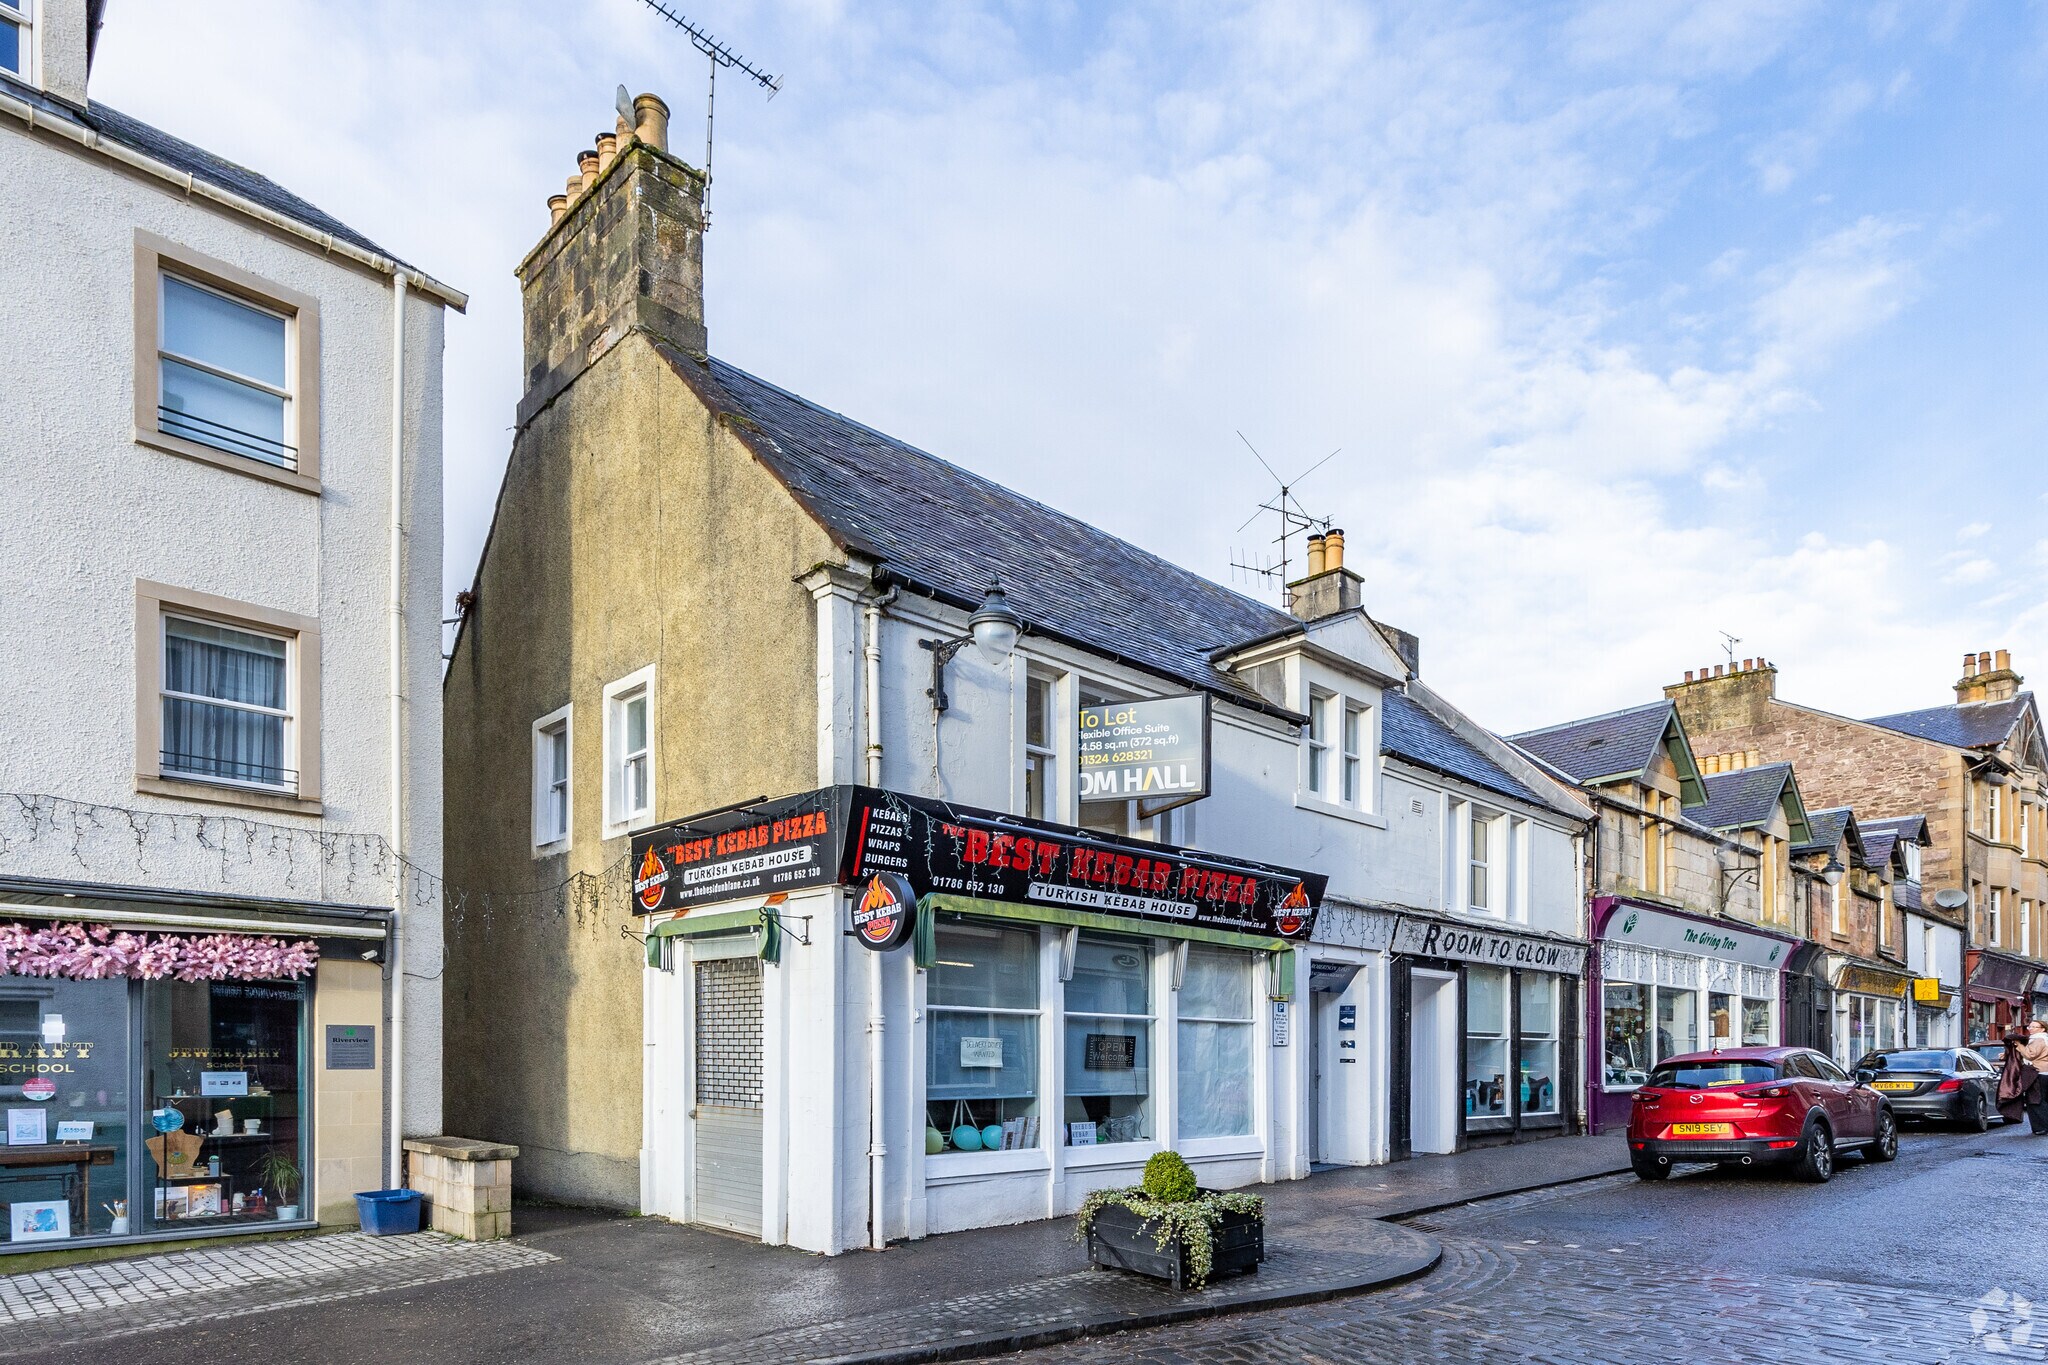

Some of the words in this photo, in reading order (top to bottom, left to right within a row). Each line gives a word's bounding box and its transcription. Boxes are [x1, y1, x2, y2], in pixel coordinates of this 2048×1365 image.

[1079, 711, 1099, 729] To
[1104, 707, 1136, 726] Let
[1078, 728, 1110, 740] lexible
[1113, 726, 1142, 737] Office
[1144, 723, 1170, 733] Suite
[1078, 741, 1103, 752] 4.58
[1104, 740, 1128, 751] sq.m
[1130, 736, 1152, 748] (372
[1153, 733, 1179, 747] sq.ft)
[1112, 749, 1152, 763] 628321
[1123, 764, 1196, 792] HALL
[872, 808, 908, 823] KEBABS
[674, 837, 714, 865] BEST
[716, 825, 769, 856] KEBAB
[772, 811, 828, 844] PIZZA
[870, 823, 903, 837] PIZZAS
[868, 838, 901, 852] WRAPS
[688, 865, 728, 881] TURKISH
[732, 857, 765, 873] KEBAB
[768, 850, 805, 866] HOUSE
[864, 853, 908, 868] BURGERS
[942, 823, 966, 838] THE
[963, 828, 1061, 875] BEST
[1070, 847, 1172, 891] KEBAB
[1178, 867, 1257, 905] PIZZA
[773, 871, 792, 884] 01786
[794, 868, 806, 880] 652
[808, 866, 820, 878] 130
[933, 876, 963, 889] 01786
[966, 880, 984, 892] 652
[987, 883, 1004, 895] 130
[1036, 885, 1098, 904] TURKISH
[1104, 895, 1146, 910] KEBAB
[1151, 902, 1191, 916] HOUSE
[854, 911, 875, 925] BEST
[876, 902, 902, 918] KEBAB
[867, 916, 891, 931] PIZZA
[1421, 923, 1484, 956] ROOM
[1489, 939, 1511, 960] TO
[1515, 943, 1561, 966] GLOW
[1683, 928, 1698, 943] The
[1699, 931, 1721, 950] Giving
[1721, 936, 1737, 950] Tree
[168, 1047, 281, 1058] JEWELLERY
[1098, 1041, 1126, 1052] OPEN
[1092, 1051, 1130, 1062] Welcome
[0, 1063, 75, 1073] SCHOOL
[1678, 1124, 1701, 1133] SN19
[1703, 1124, 1723, 1133] SEY
